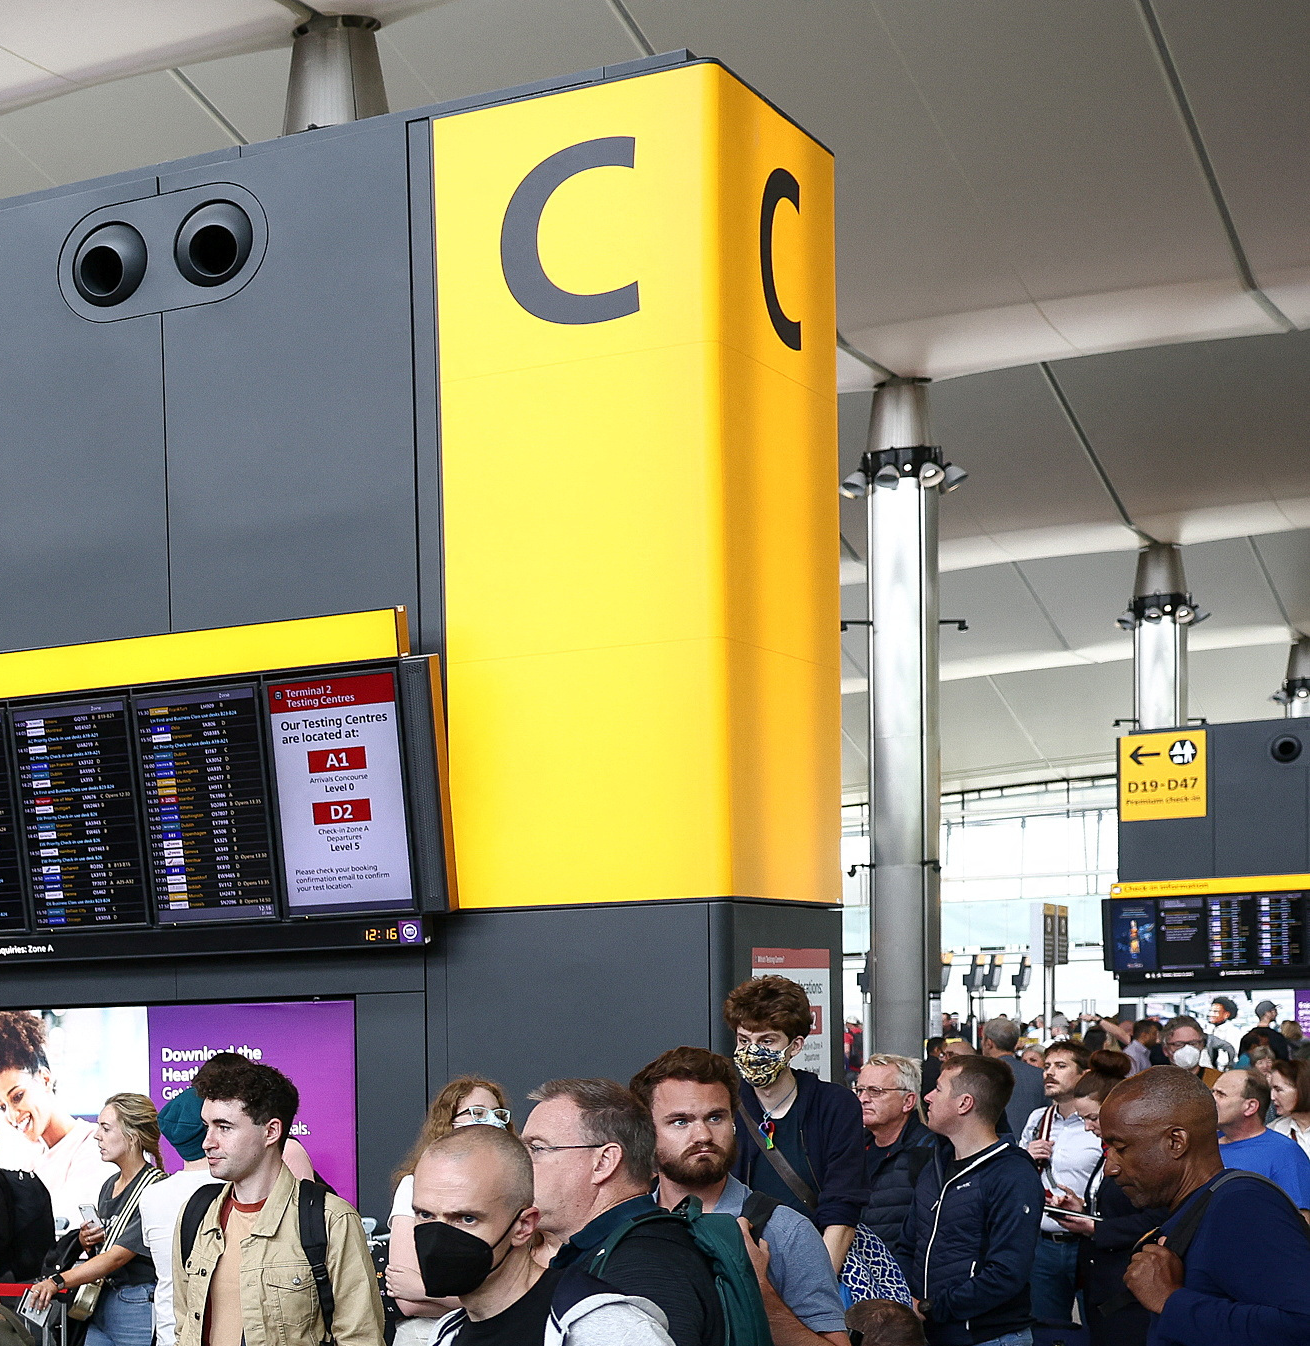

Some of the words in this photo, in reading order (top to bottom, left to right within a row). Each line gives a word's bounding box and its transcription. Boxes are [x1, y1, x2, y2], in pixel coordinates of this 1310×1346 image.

[500, 136, 640, 325] C
[760, 168, 801, 351] C
[285, 686, 324, 697] Terminal
[326, 685, 332, 693] 2
[286, 698, 319, 708] Testing
[321, 694, 355, 703] Centres
[281, 721, 300, 731] Our
[302, 717, 342, 729] Testing
[345, 713, 387, 724] Centres
[282, 735, 299, 744] are
[302, 730, 342, 742] located
[345, 729, 359, 738] at:
[326, 752, 349, 768] A1
[310, 775, 333, 784] Arrivals
[335, 774, 368, 782] Concourse
[325, 784, 347, 793] Level
[349, 783, 354, 791] 0
[330, 805, 353, 820] D2
[318, 827, 346, 835] Check-in
[327, 834, 362, 843] Departures
[331, 843, 353, 851] Level
[355, 842, 360, 850] 5
[351, 864, 378, 872] booking
[296, 876, 337, 884] confirmation
[365, 928, 397, 941] 12:16
[28, 946, 46, 954] Zone
